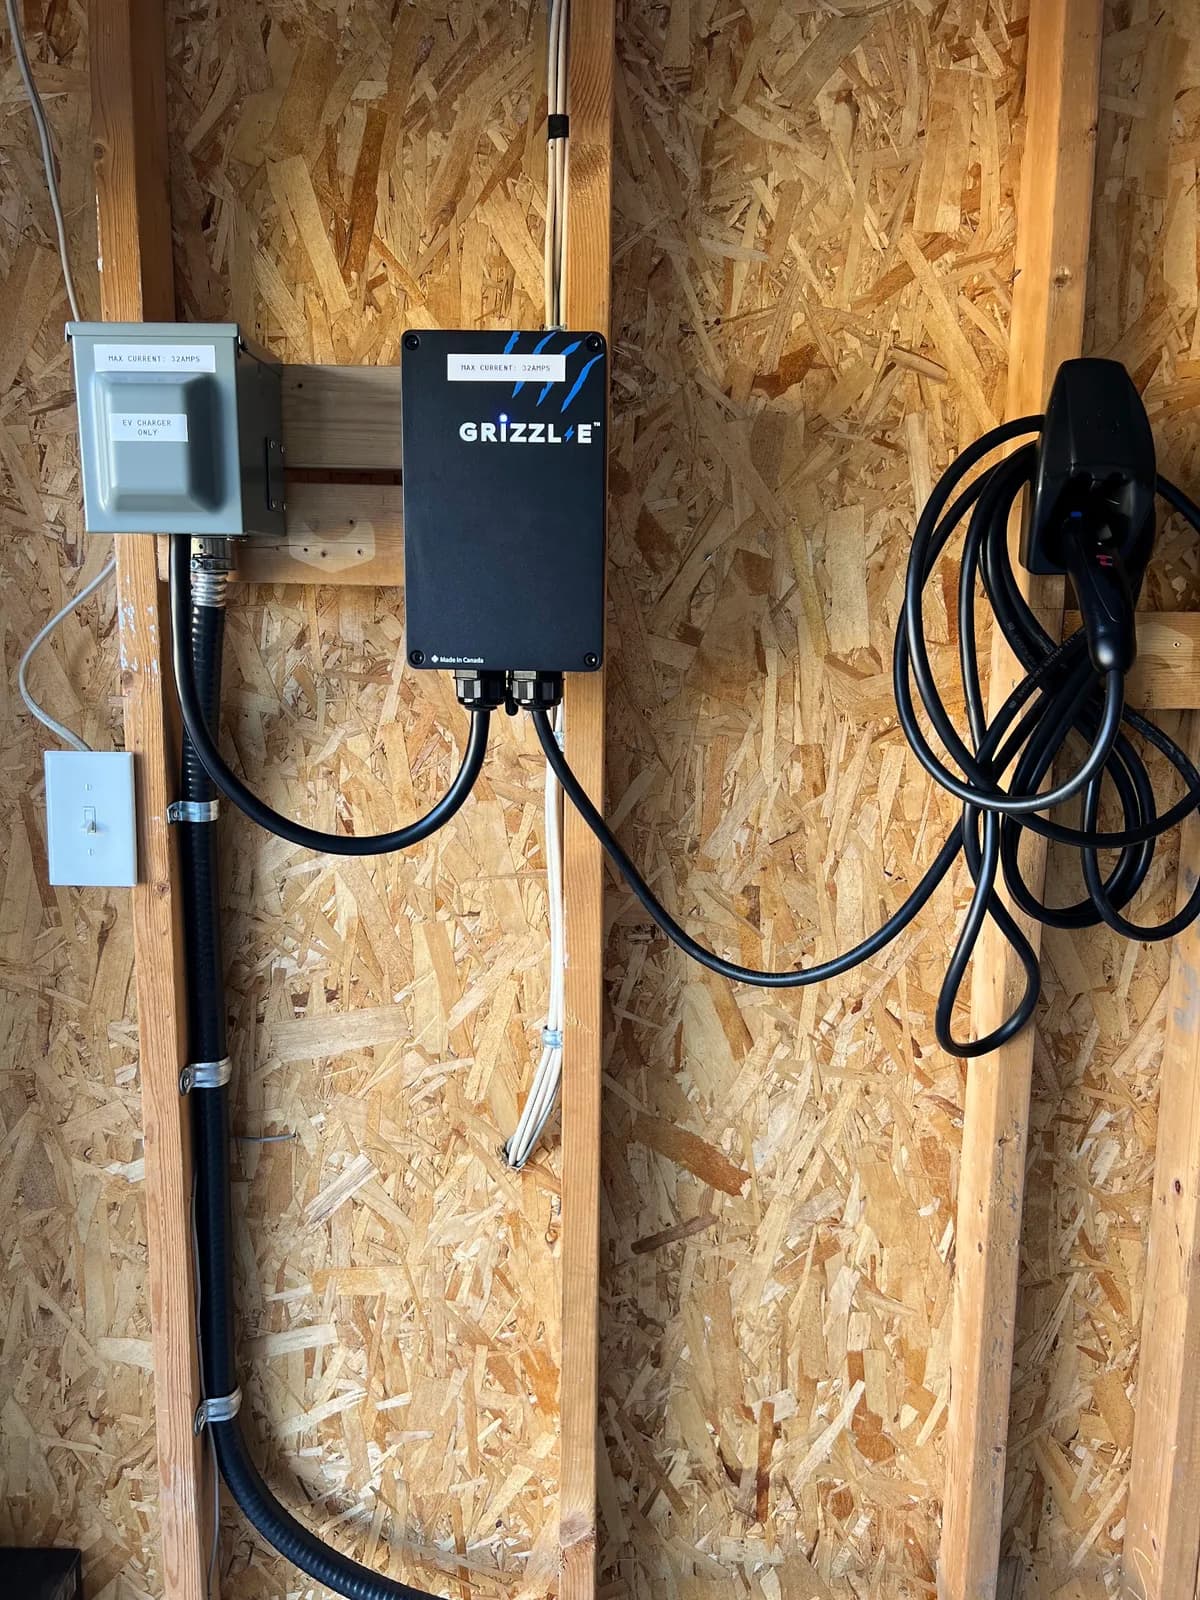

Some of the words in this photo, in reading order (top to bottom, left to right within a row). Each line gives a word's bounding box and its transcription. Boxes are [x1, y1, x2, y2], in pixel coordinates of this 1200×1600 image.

[171, 355, 201, 363] 32AMPS
[461, 364, 475, 372] MAX
[479, 364, 517, 372] CURRENT:
[522, 364, 551, 372] 32AMPS
